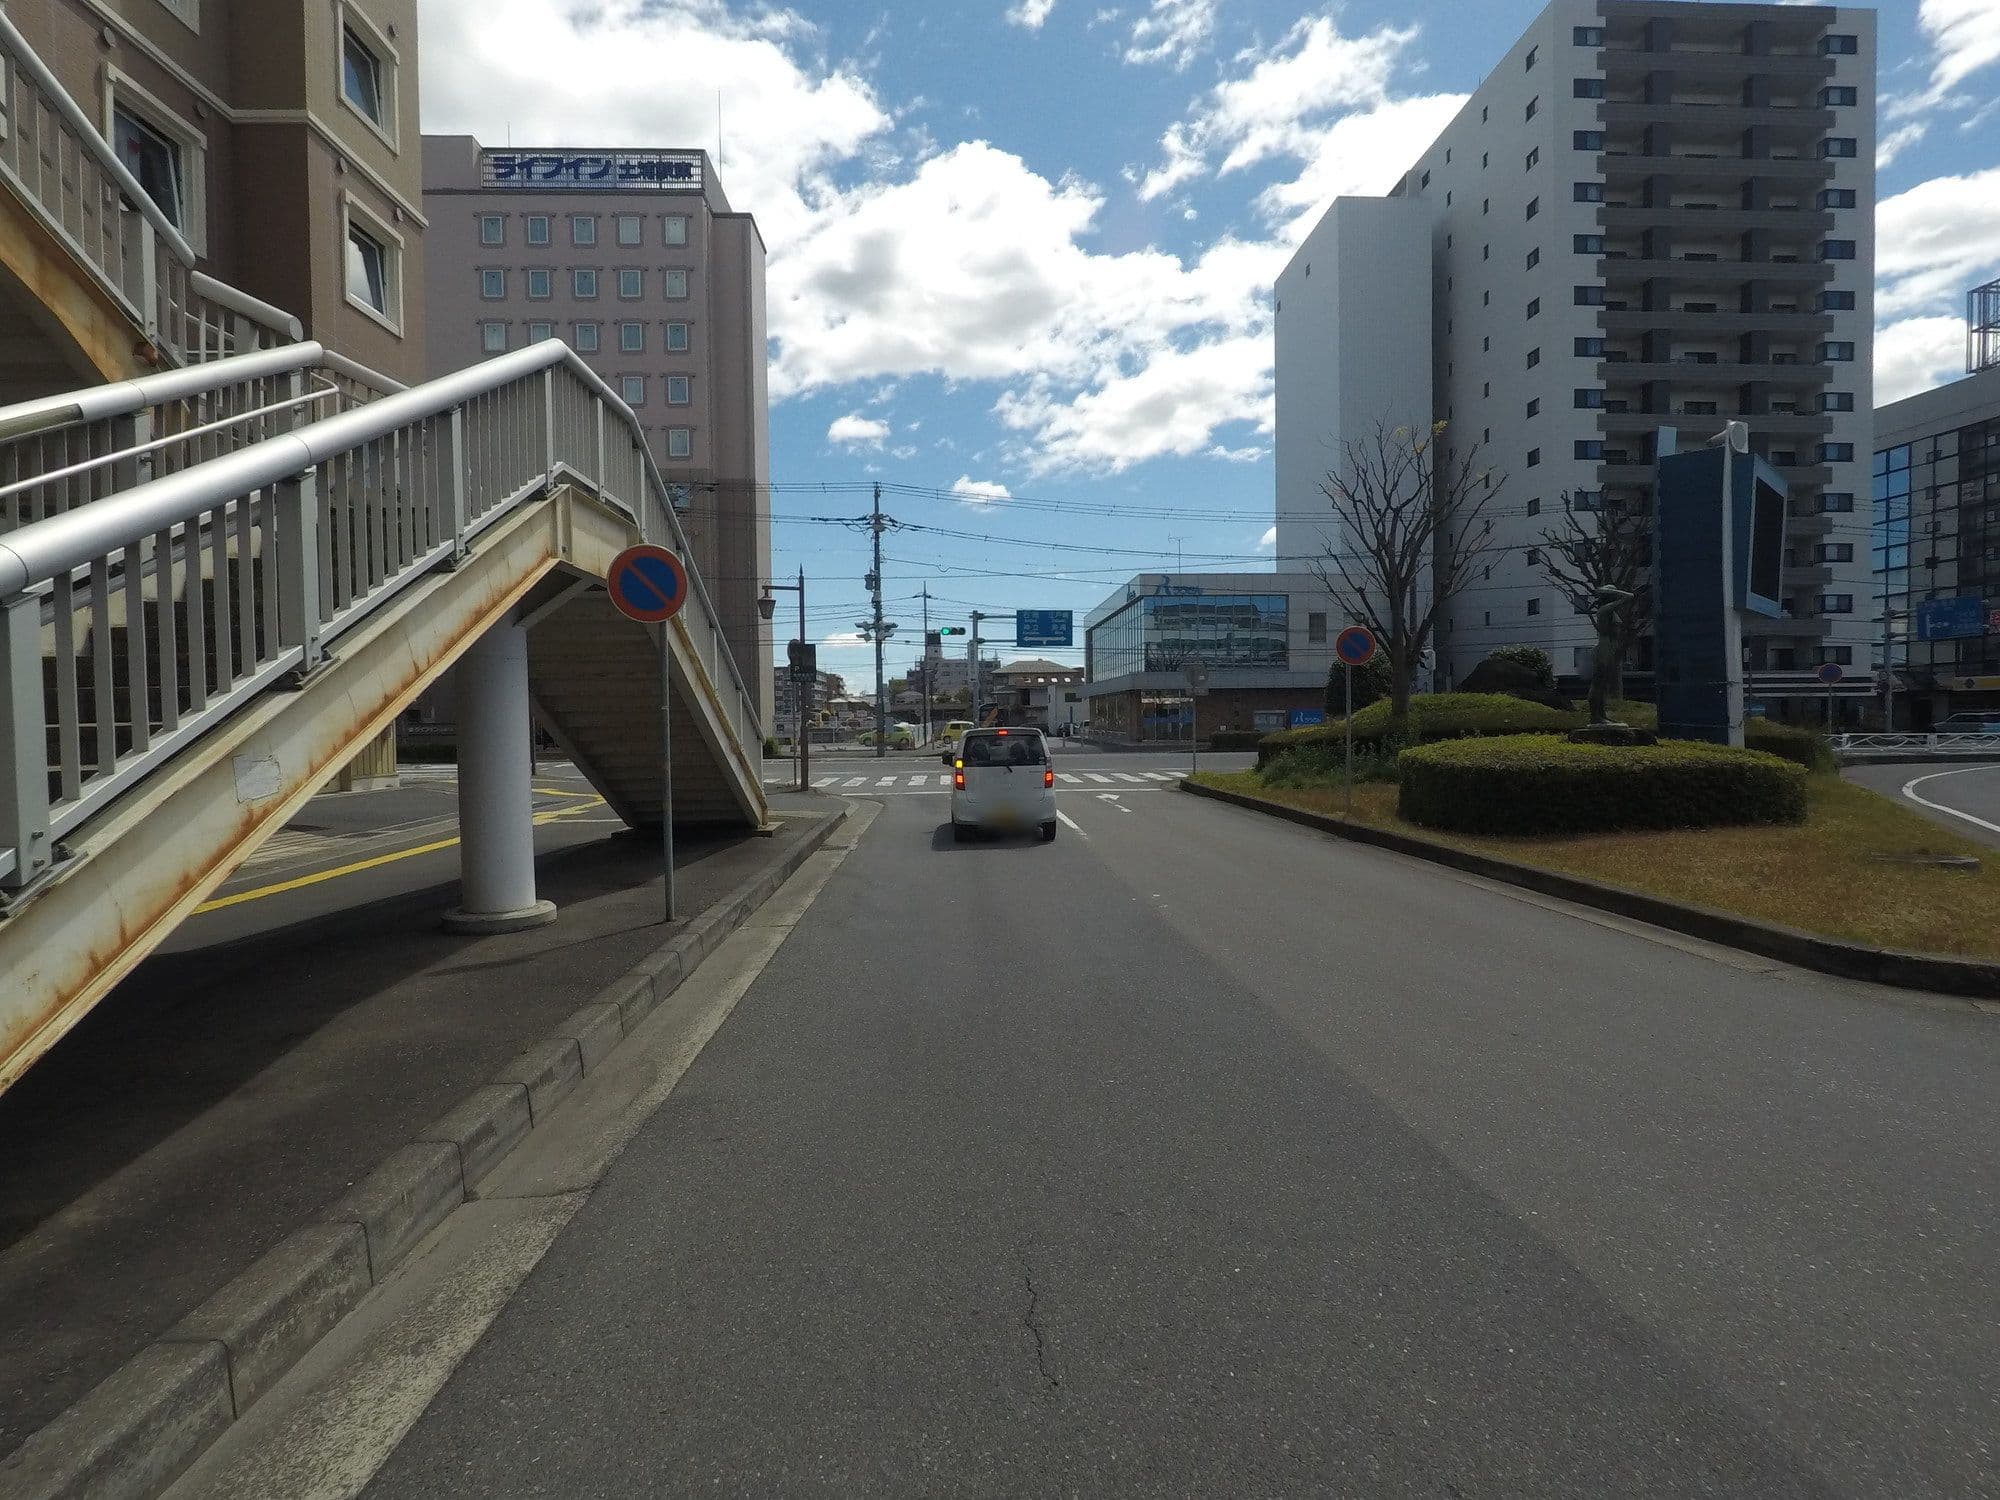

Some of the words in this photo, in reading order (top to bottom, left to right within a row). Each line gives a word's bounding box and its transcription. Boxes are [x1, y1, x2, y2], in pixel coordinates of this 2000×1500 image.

[493, 156, 611, 180] ライフイン
